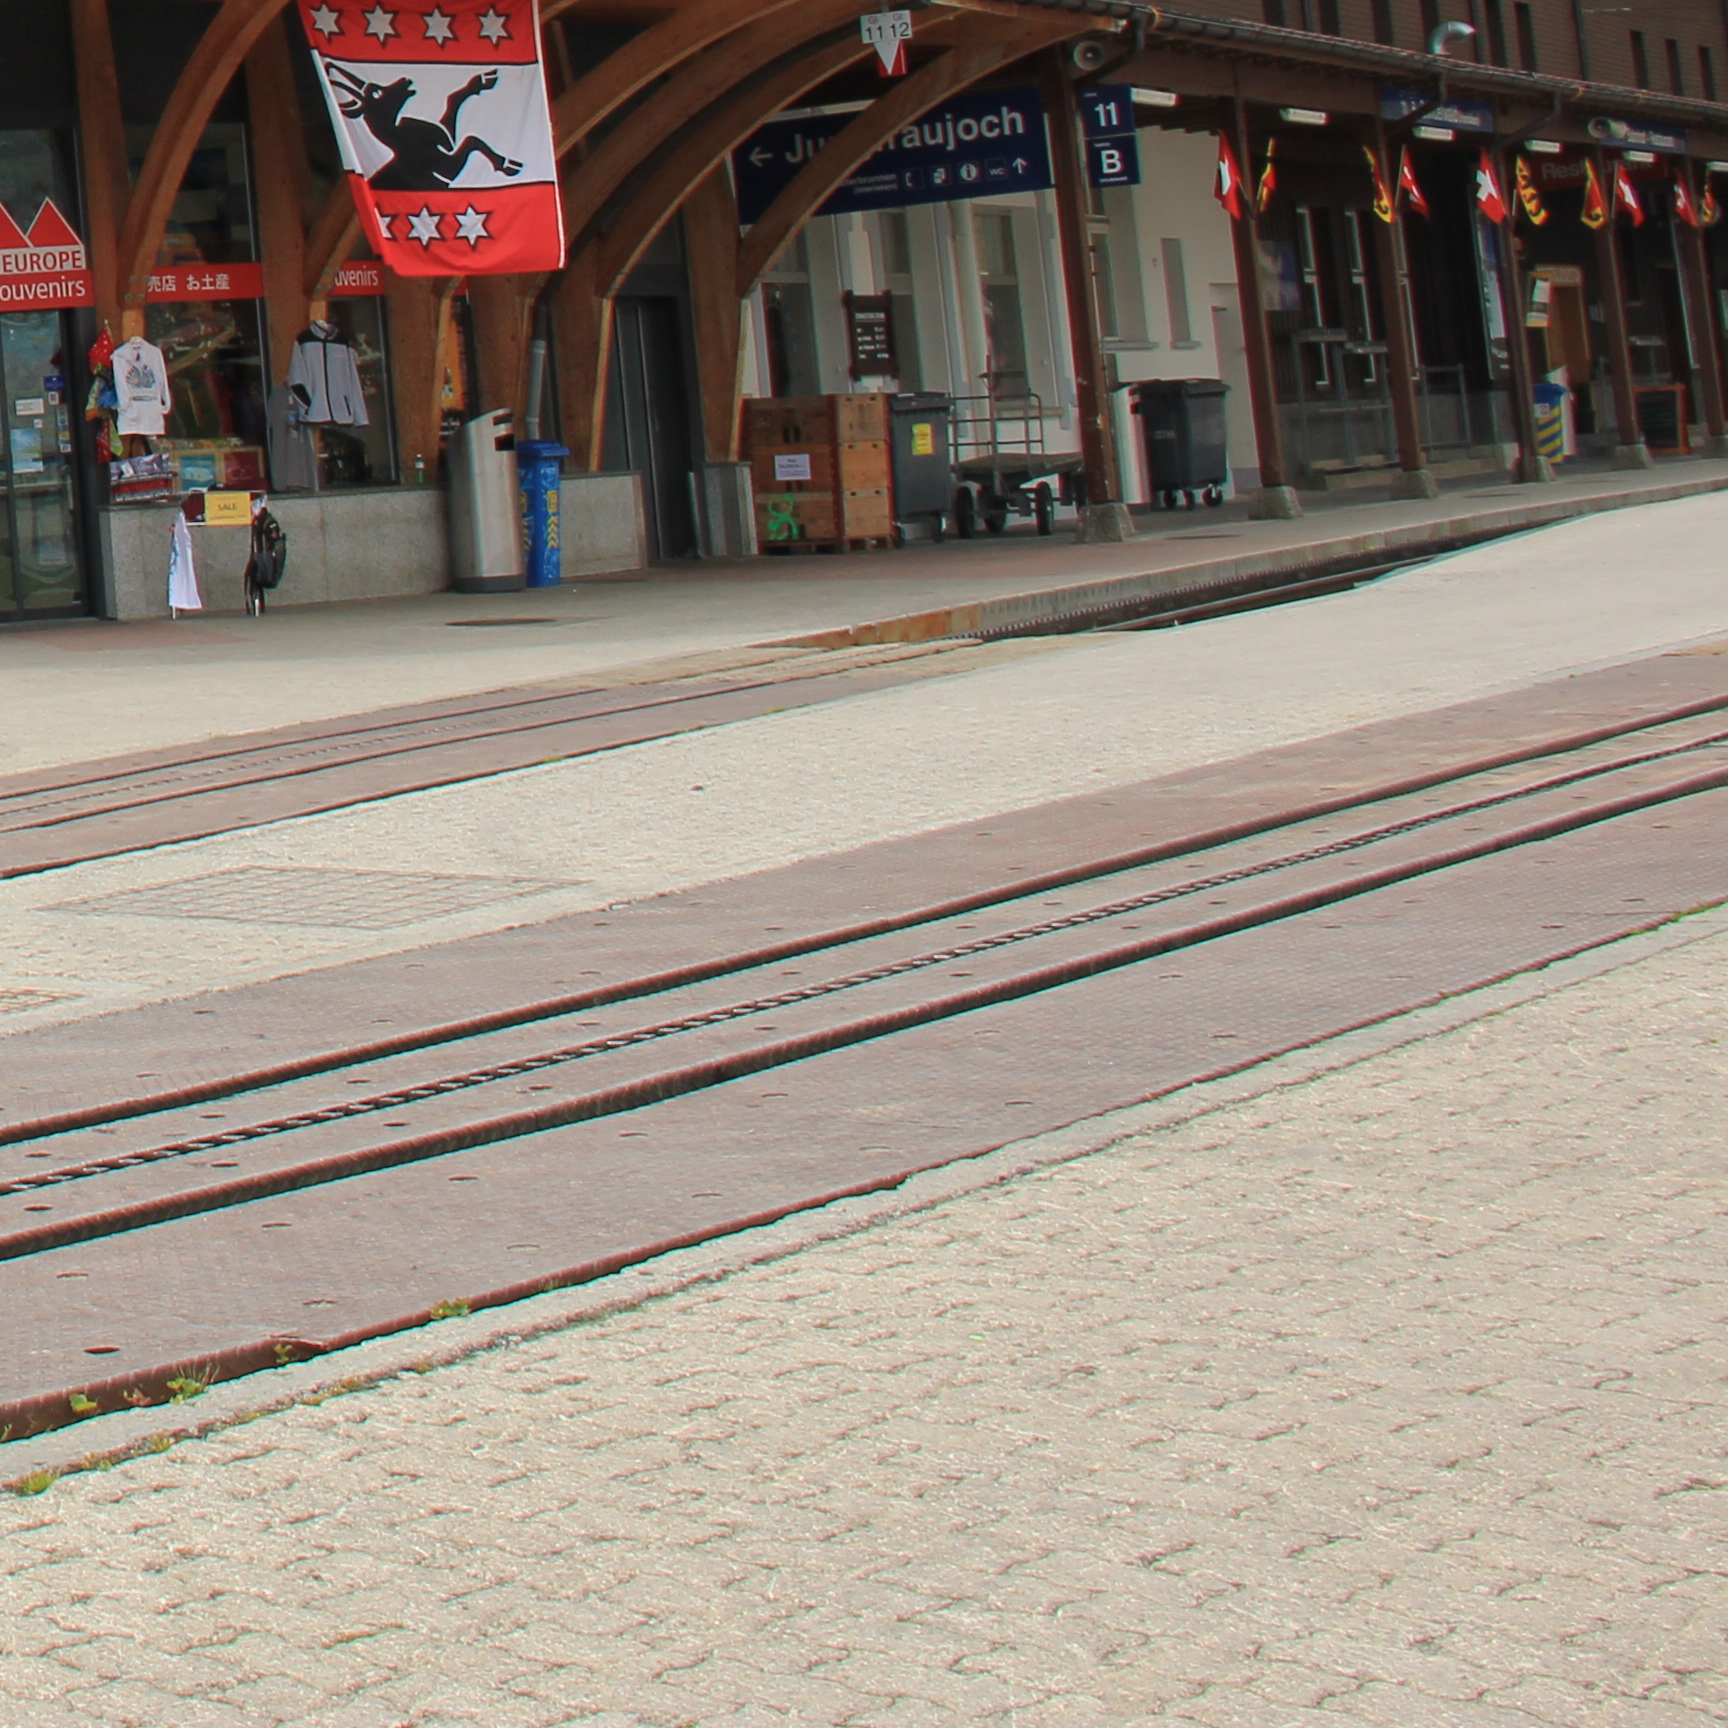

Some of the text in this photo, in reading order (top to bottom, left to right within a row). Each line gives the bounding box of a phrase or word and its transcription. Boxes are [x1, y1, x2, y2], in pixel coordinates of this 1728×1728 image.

[865, 21, 910, 41] 11 12
[1094, 101, 1118, 127] 11
[1100, 149, 1122, 174] B
[1, 250, 83, 273] EUROPE
[148, 273, 230, 292] 売店 お土産
[335, 265, 379, 287] uvenirs
[217, 503, 238, 511] SALE
